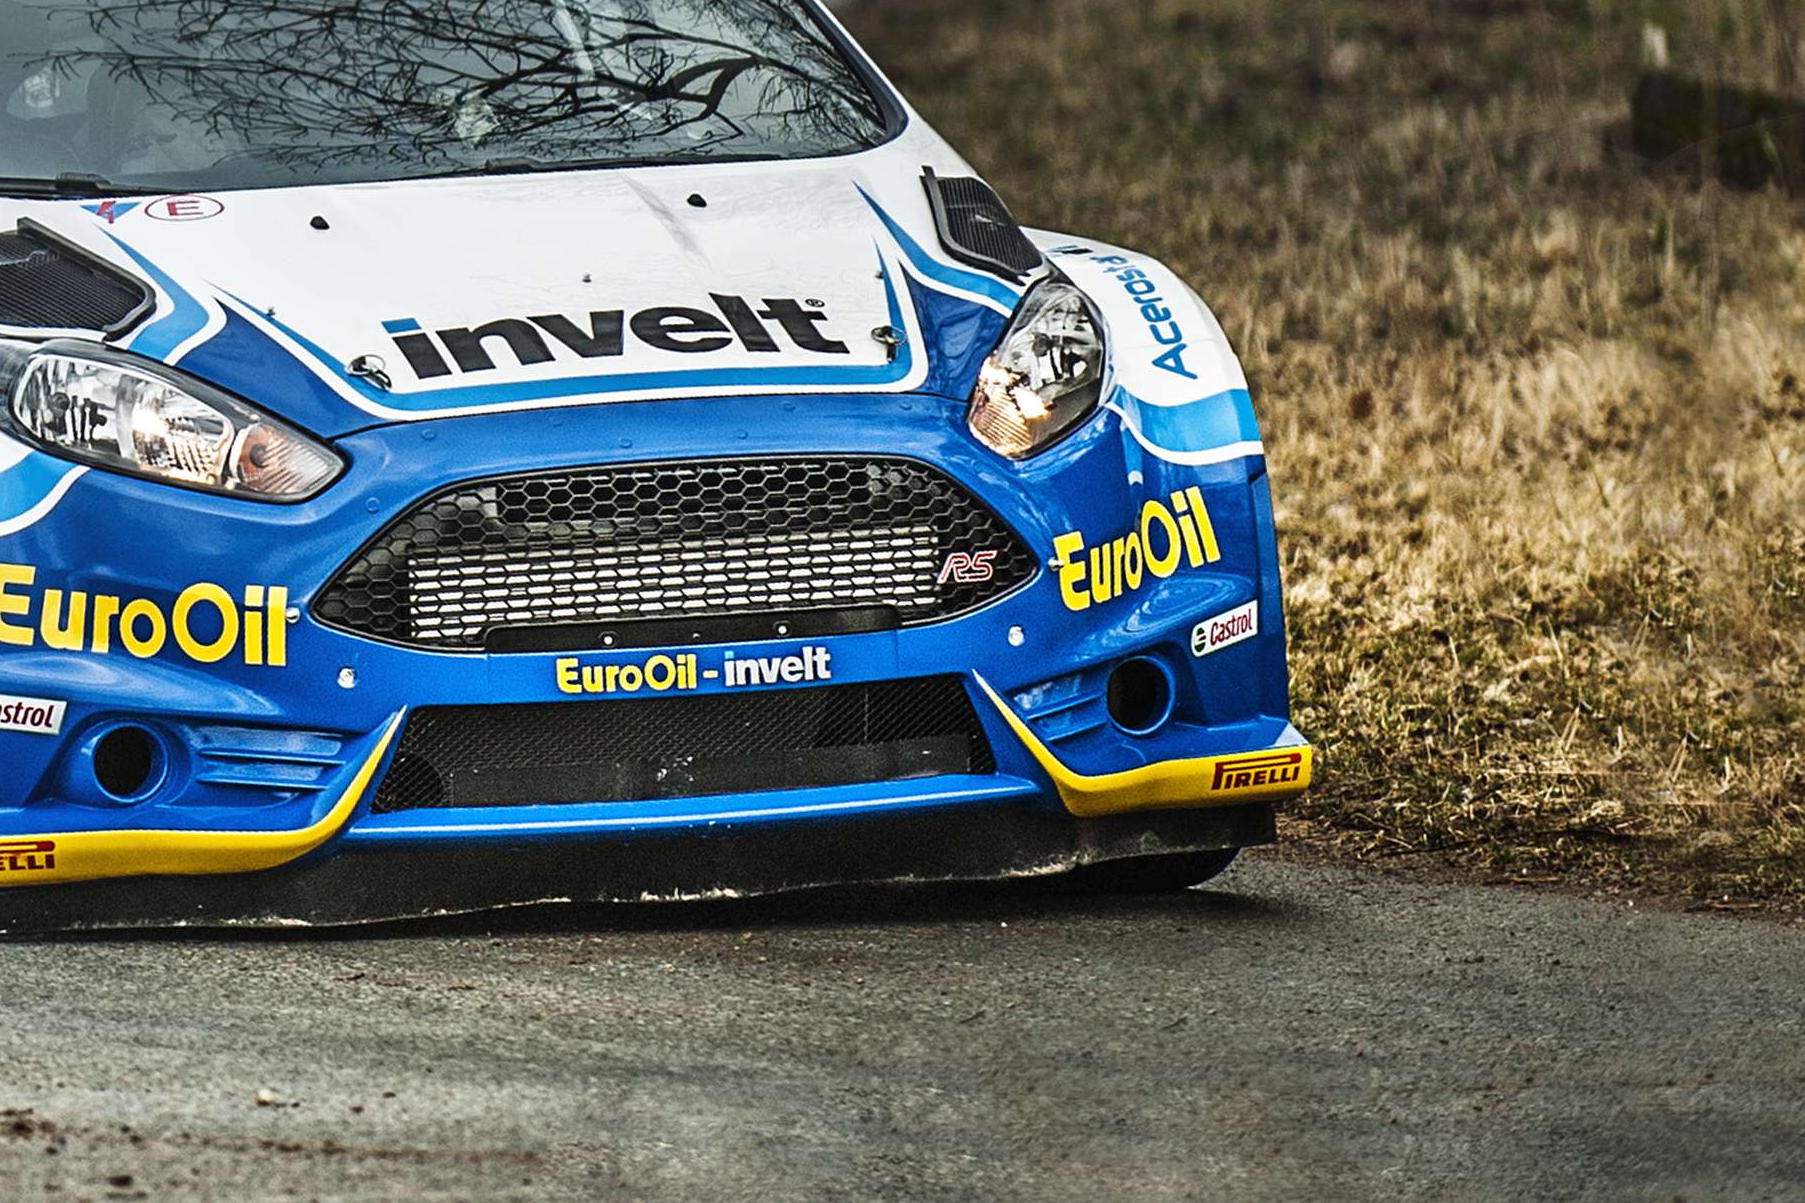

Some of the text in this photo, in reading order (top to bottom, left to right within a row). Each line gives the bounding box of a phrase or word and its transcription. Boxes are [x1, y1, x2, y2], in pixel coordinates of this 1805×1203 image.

[381, 292, 850, 379] invelt
[1090, 256, 1198, 380] Acerostar
[1053, 486, 1220, 610] EuroOil
[1209, 608, 1253, 647] Castrol
[556, 653, 696, 692] EuroOil
[724, 647, 831, 686] invelt
[1211, 752, 1301, 790] PIRELLI
